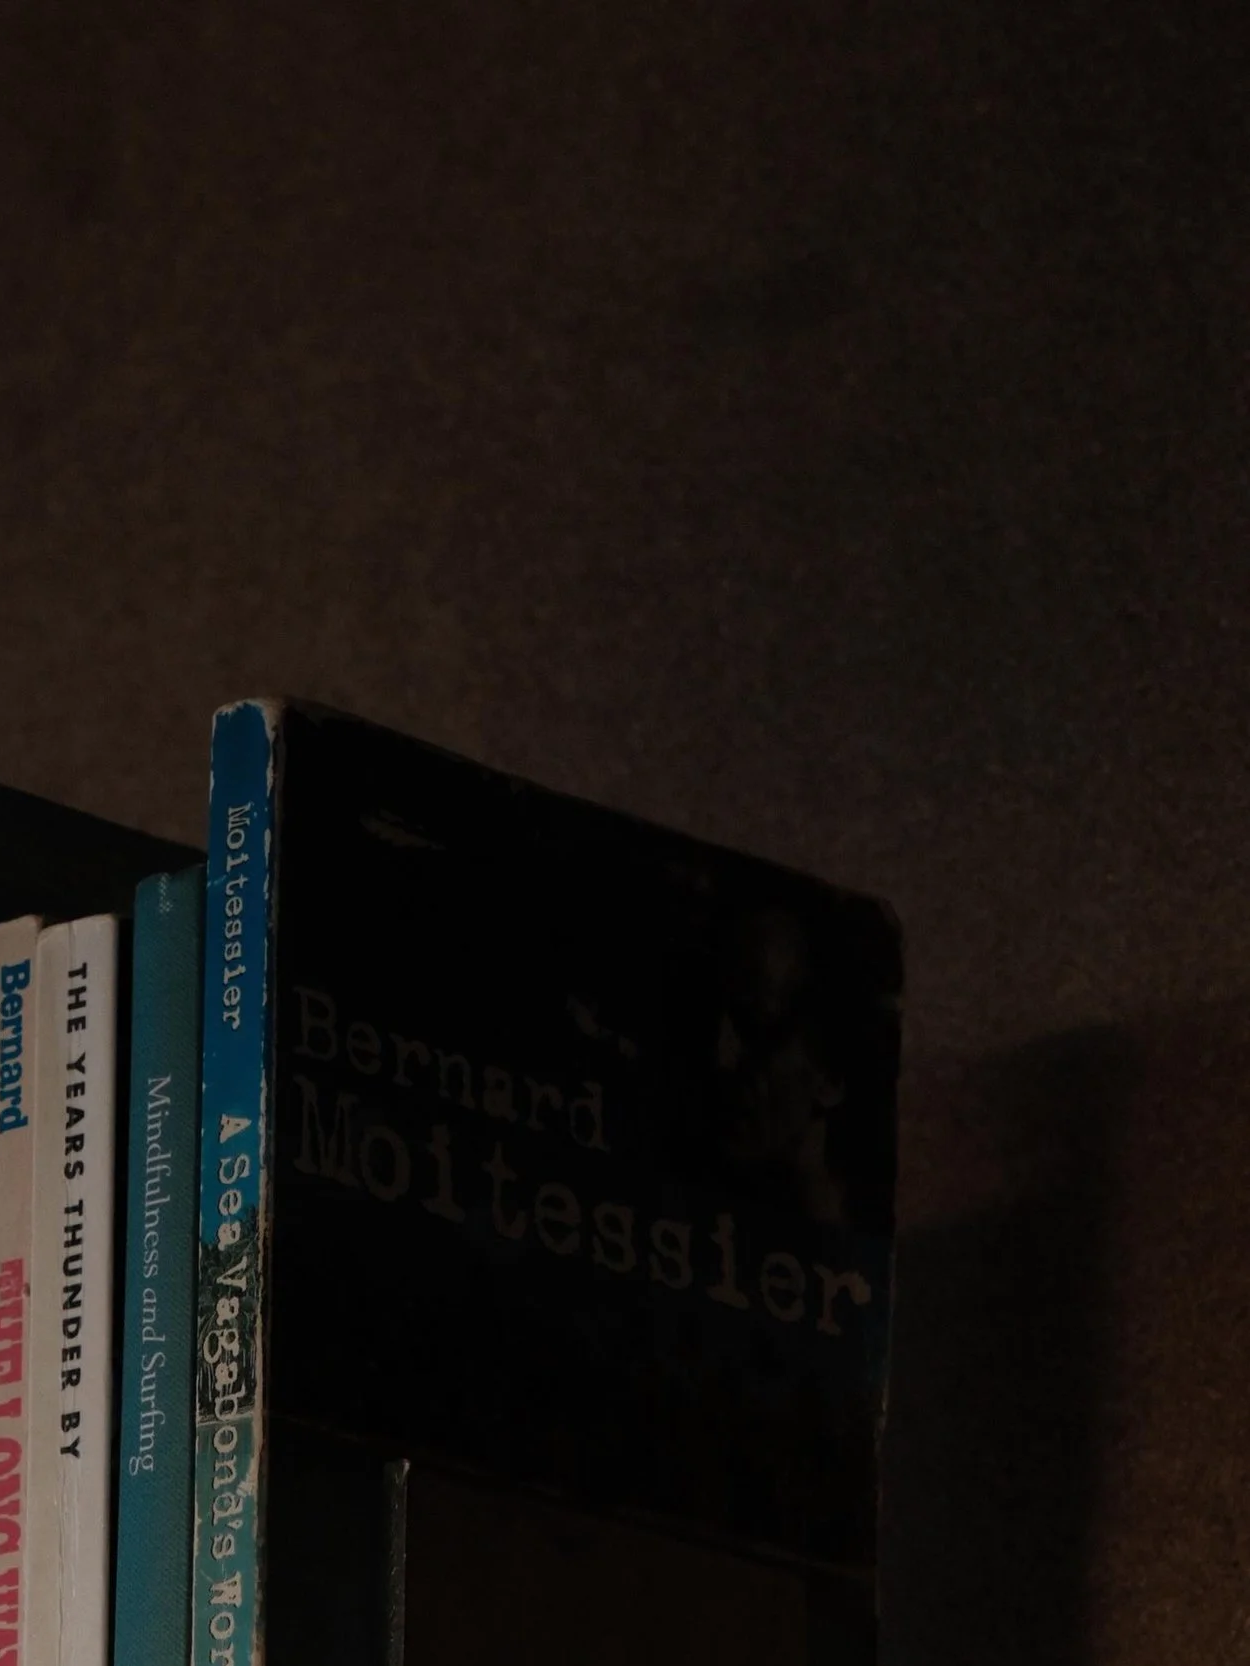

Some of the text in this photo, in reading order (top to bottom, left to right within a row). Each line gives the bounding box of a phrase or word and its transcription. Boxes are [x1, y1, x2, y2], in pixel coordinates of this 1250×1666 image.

[220, 804, 251, 1031] Moitessier
[218, 1113, 252, 1143] A
[292, 984, 611, 1155] Bernard
[58, 962, 87, 1460] THE YEARS THUNDER BY
[127, 1074, 171, 1477] Mindfulness and Surfing
[215, 1153, 251, 1251] Sea
[291, 1074, 872, 1337] Moitessier
[201, 1256, 248, 1560] Vagabond's
